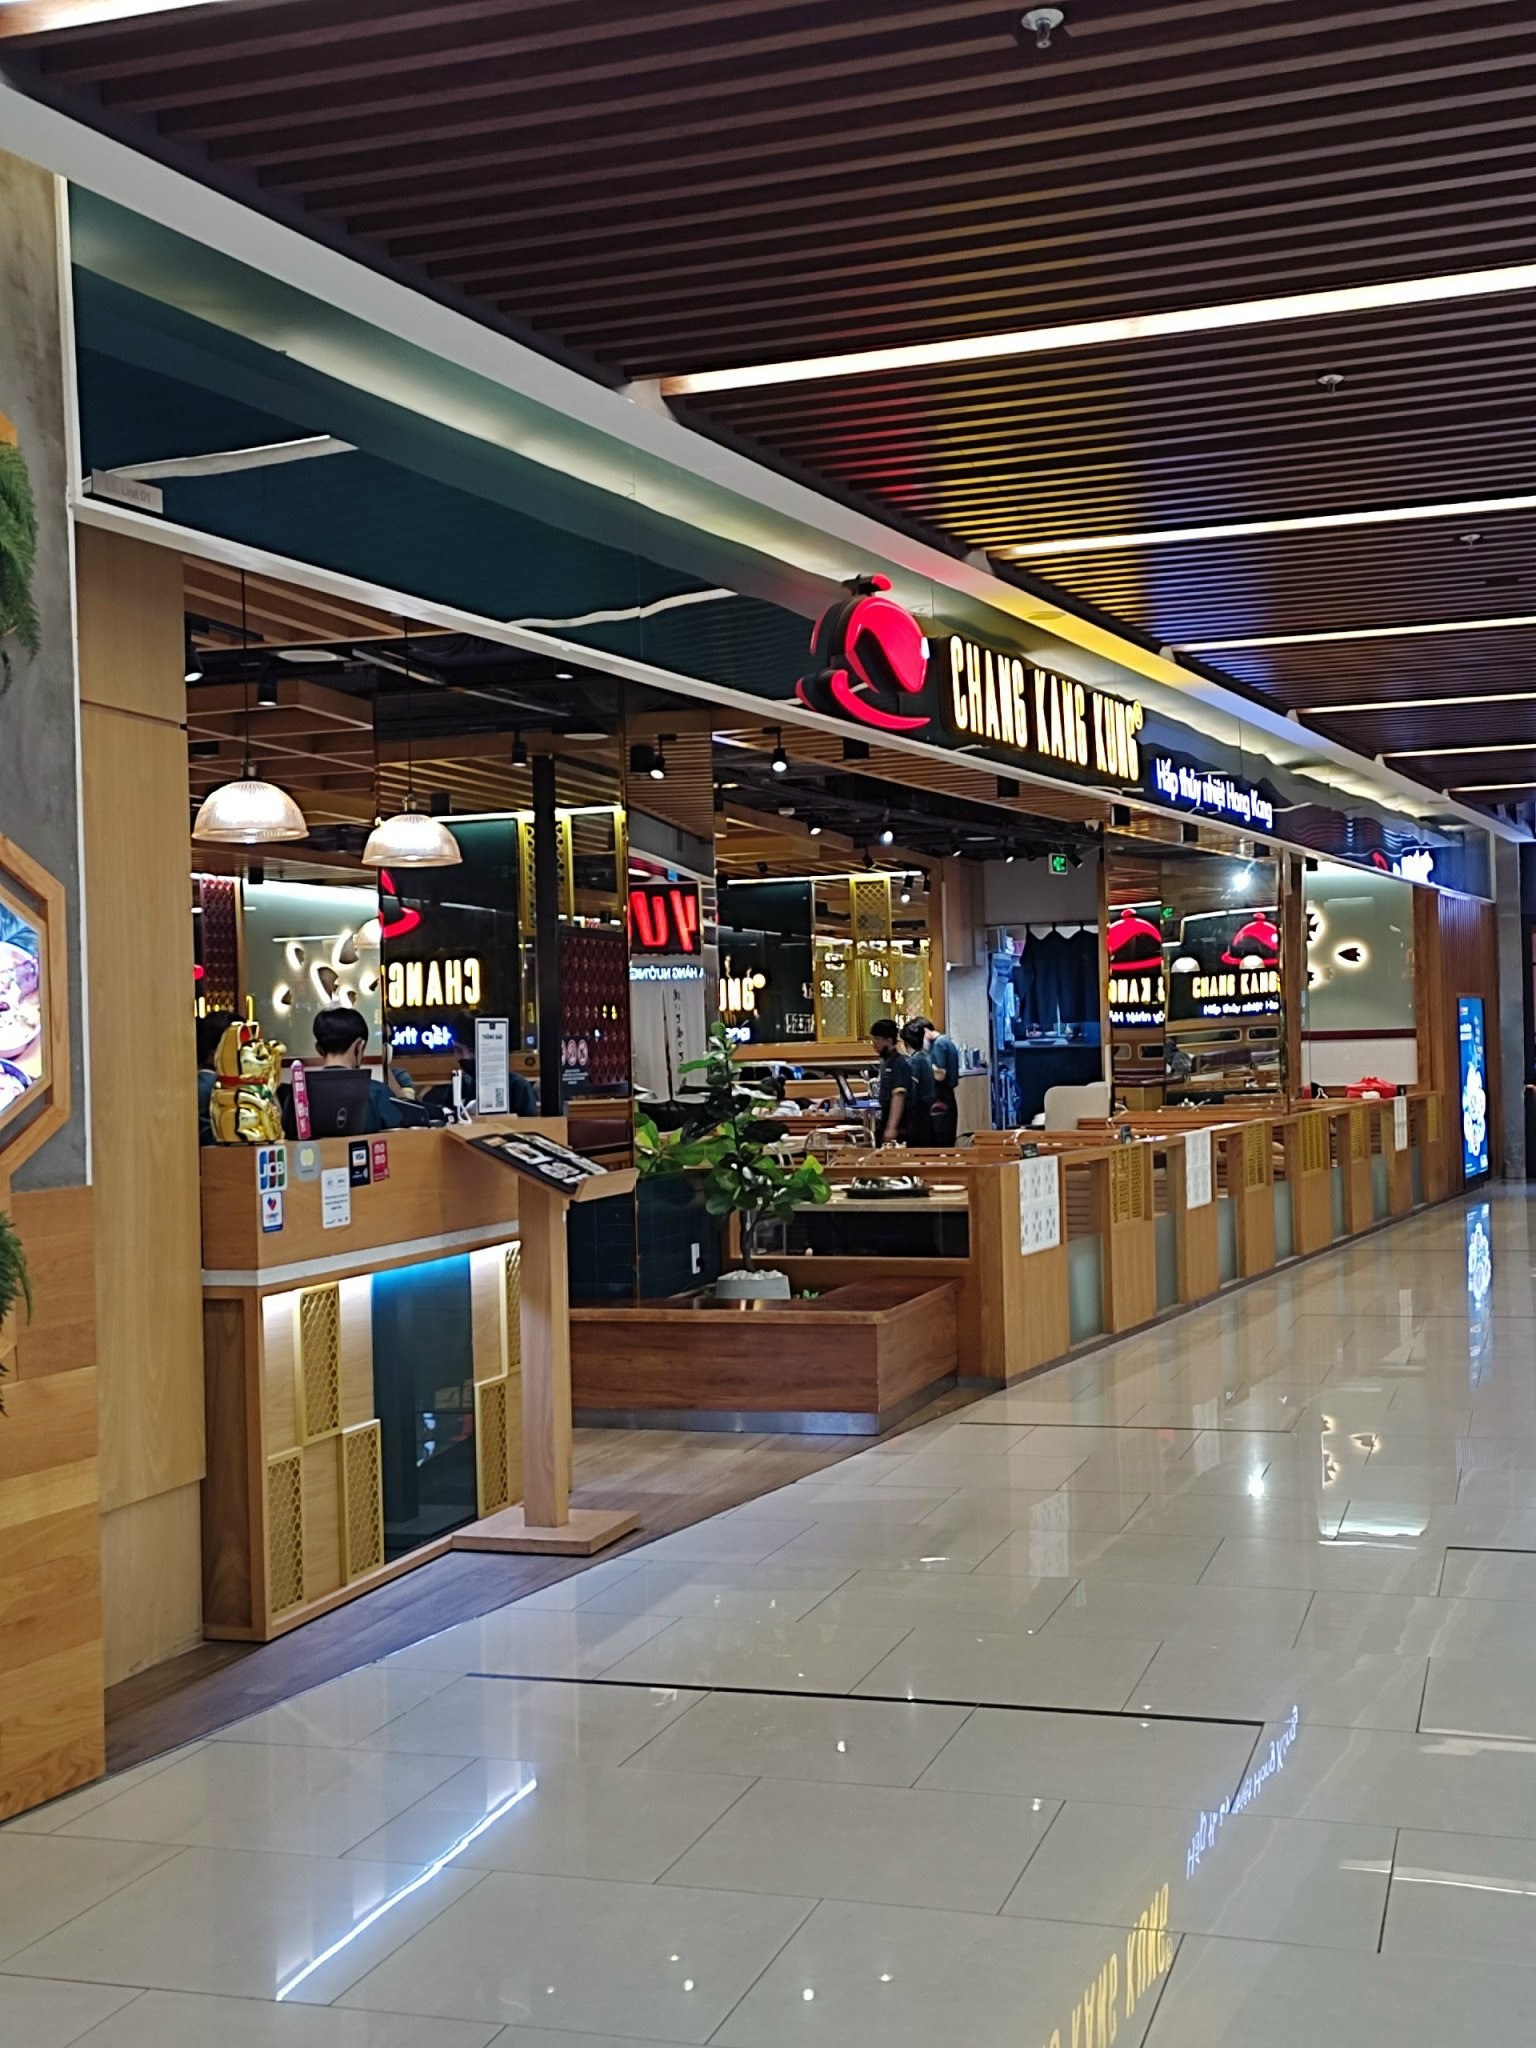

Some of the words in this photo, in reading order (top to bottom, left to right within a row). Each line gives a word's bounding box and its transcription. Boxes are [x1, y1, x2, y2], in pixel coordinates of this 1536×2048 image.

[951, 636, 1028, 748] CHANG
[1034, 668, 1088, 766] KANG
[1226, 780, 1251, 822] Hong
[1250, 788, 1273, 829] Kong
[259, 1160, 285, 1178] JCB
